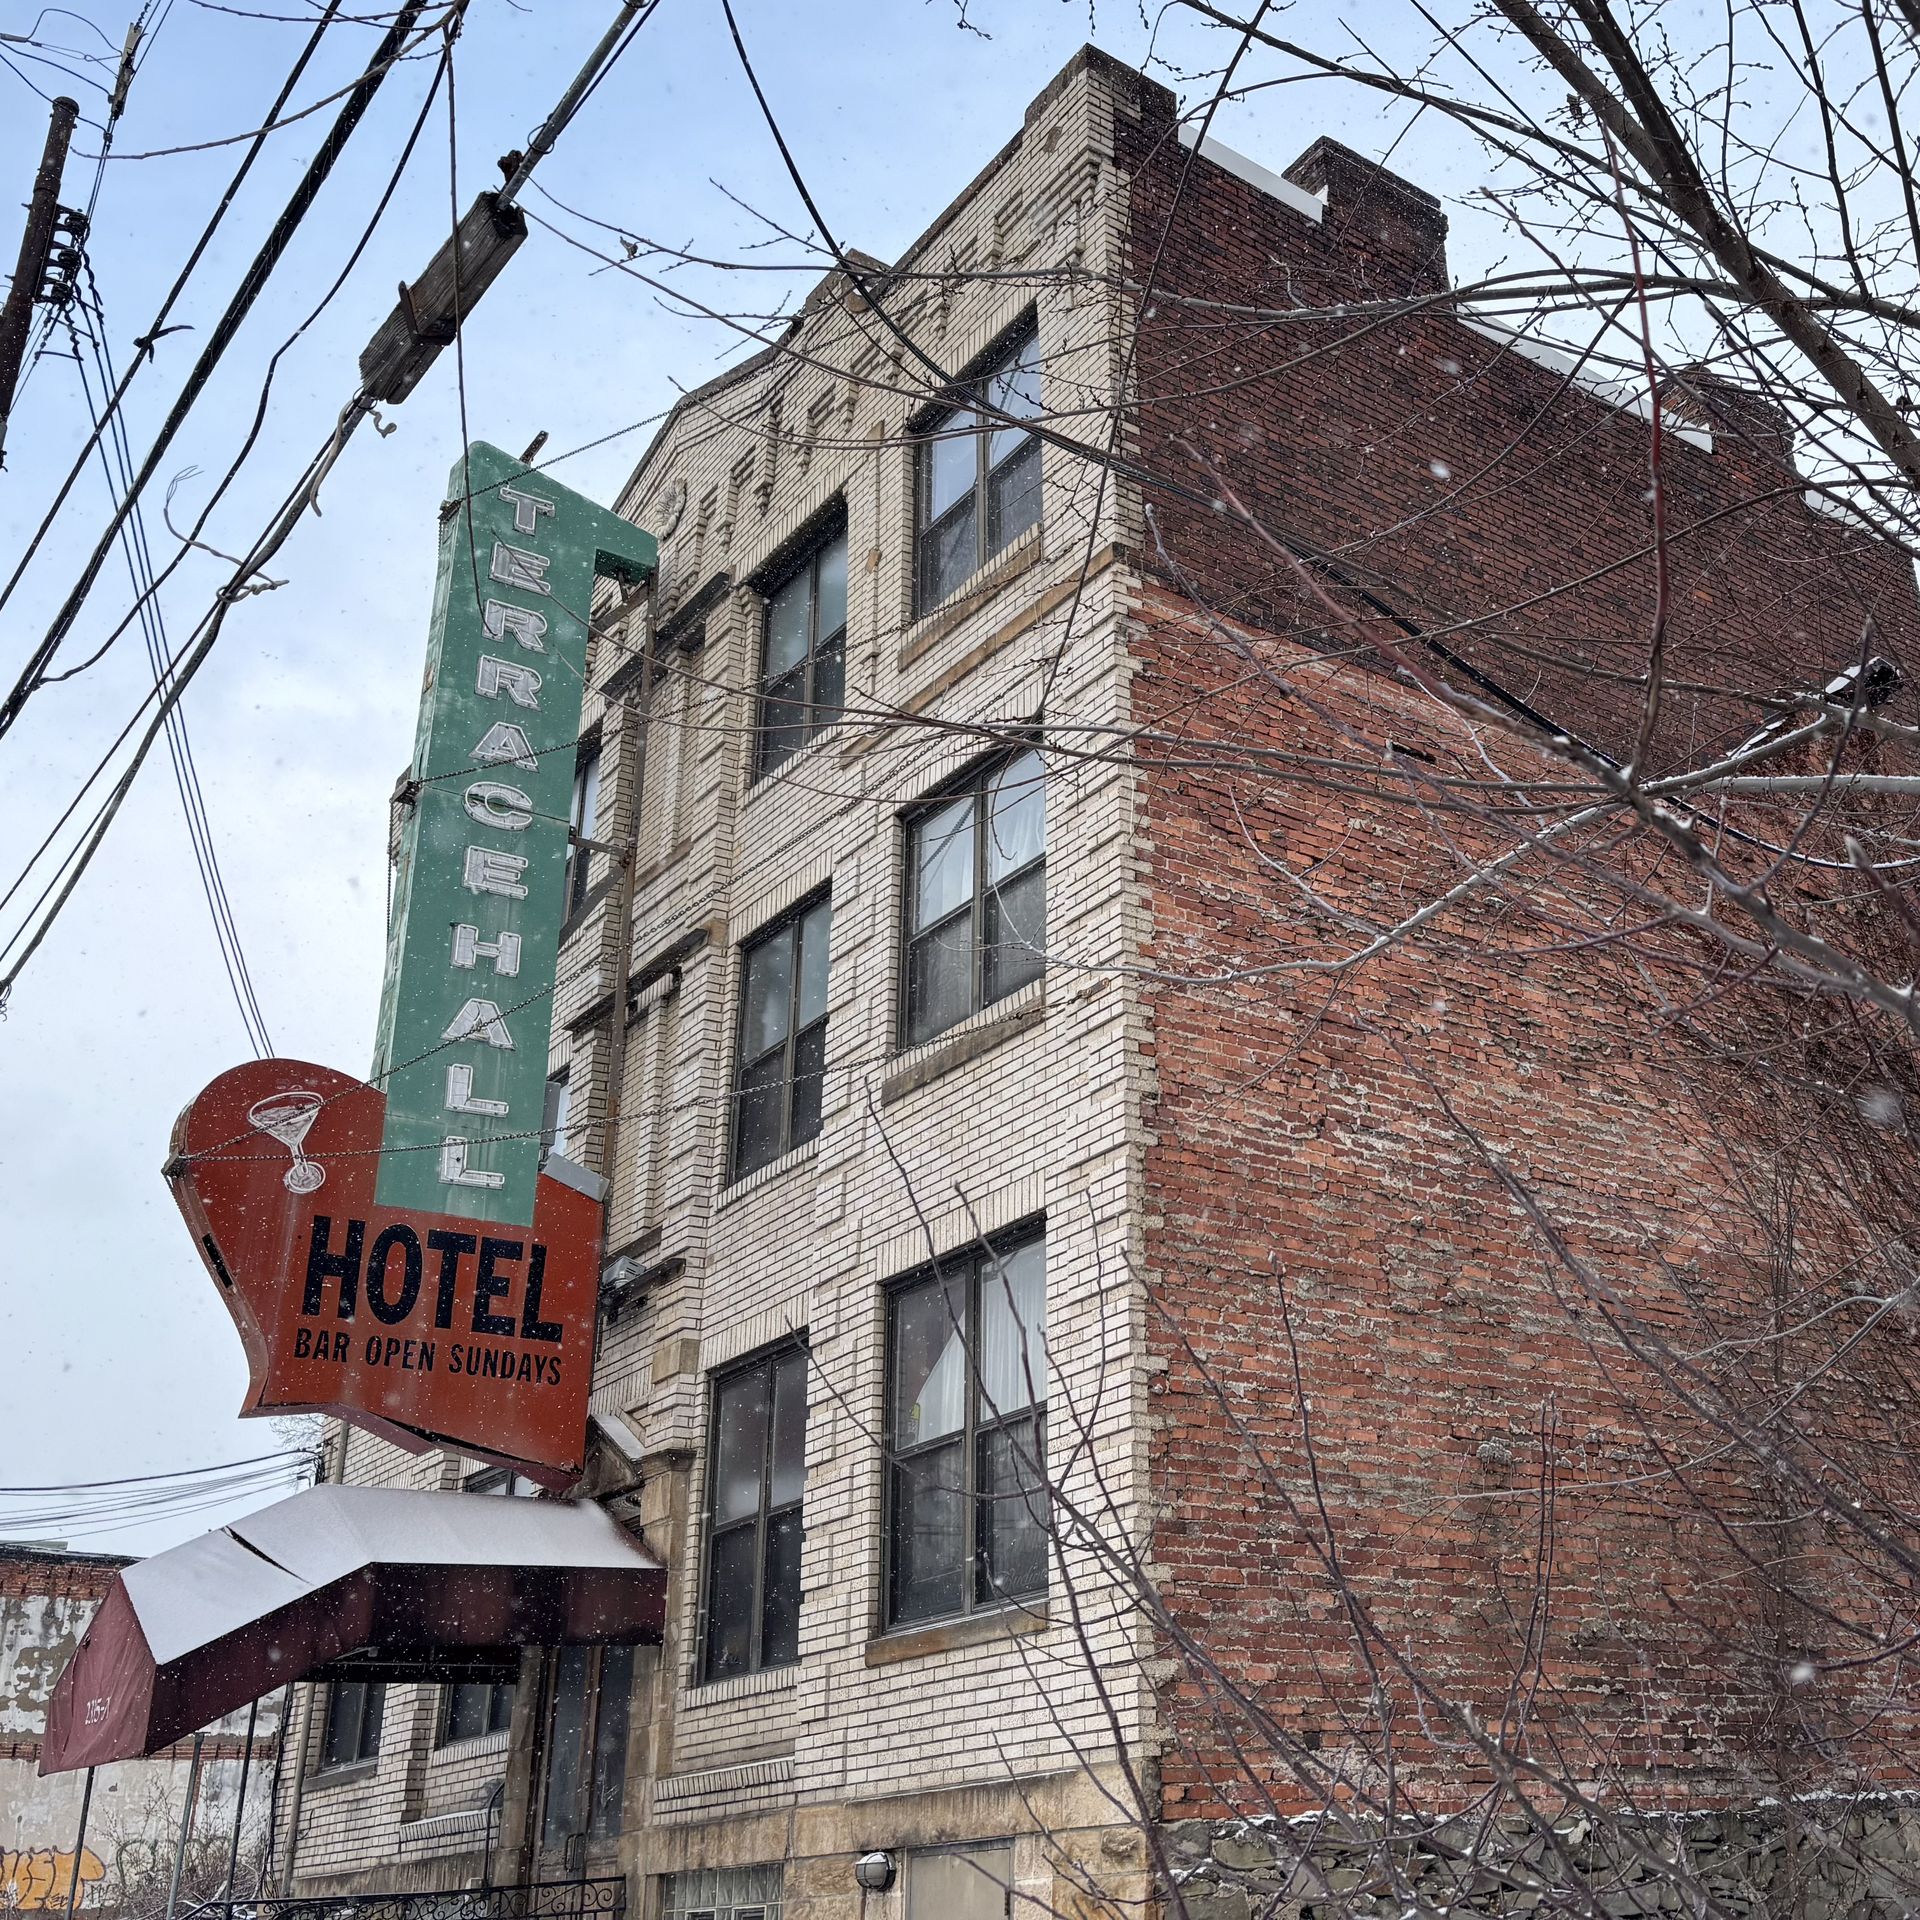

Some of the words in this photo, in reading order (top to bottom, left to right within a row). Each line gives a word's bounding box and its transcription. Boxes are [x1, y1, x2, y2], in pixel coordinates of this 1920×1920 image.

[463, 483, 556, 901] TERRACE
[438, 923, 522, 1190] HALL
[294, 1327, 350, 1363] BAR
[365, 1335, 436, 1372] OPEN
[448, 1343, 563, 1386] SUNDAYS
[301, 1214, 564, 1344] HOTEL
